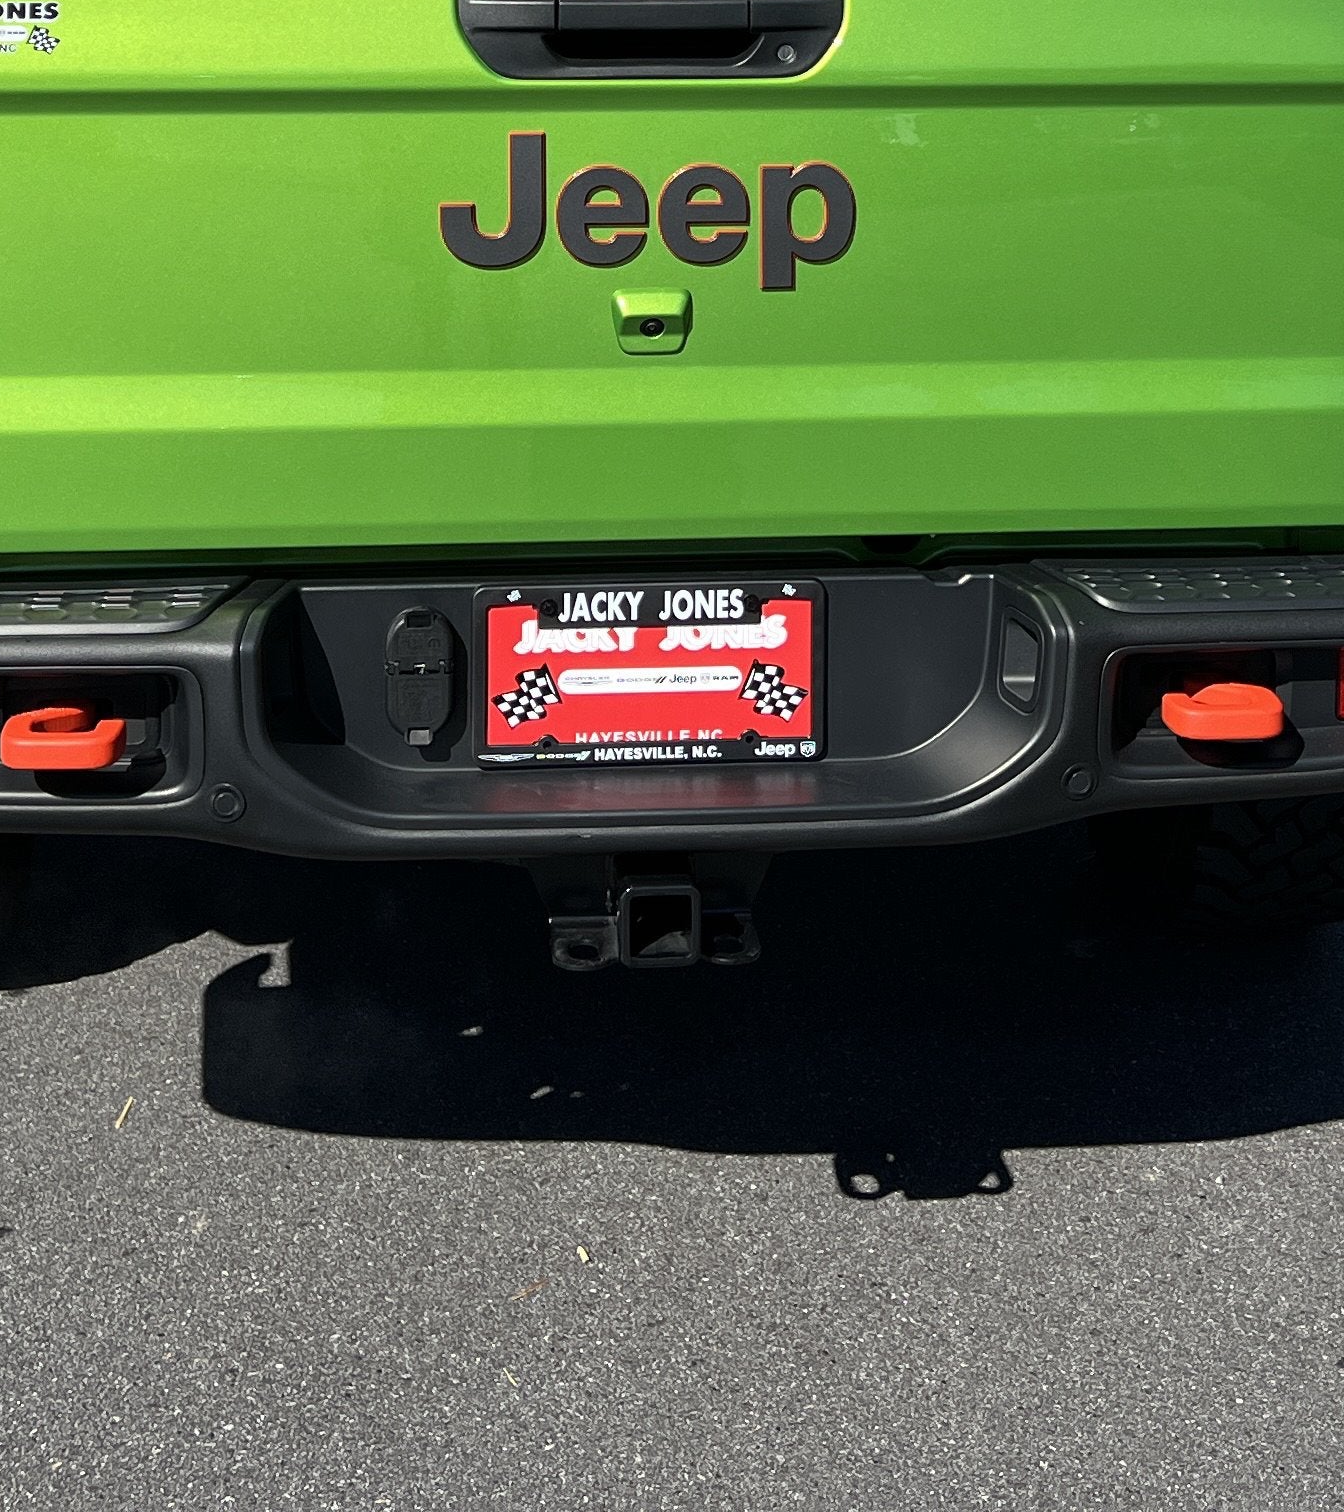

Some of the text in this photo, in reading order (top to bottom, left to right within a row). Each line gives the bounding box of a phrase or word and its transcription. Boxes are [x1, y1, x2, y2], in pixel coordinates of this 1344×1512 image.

[0, 43, 17, 53] NC
[438, 129, 857, 292] Jeep
[557, 588, 745, 623] JACKY JONES
[668, 673, 697, 685] Jeep
[593, 744, 723, 762] HAYESVILLE, N.C.
[754, 740, 796, 758] Jeep
